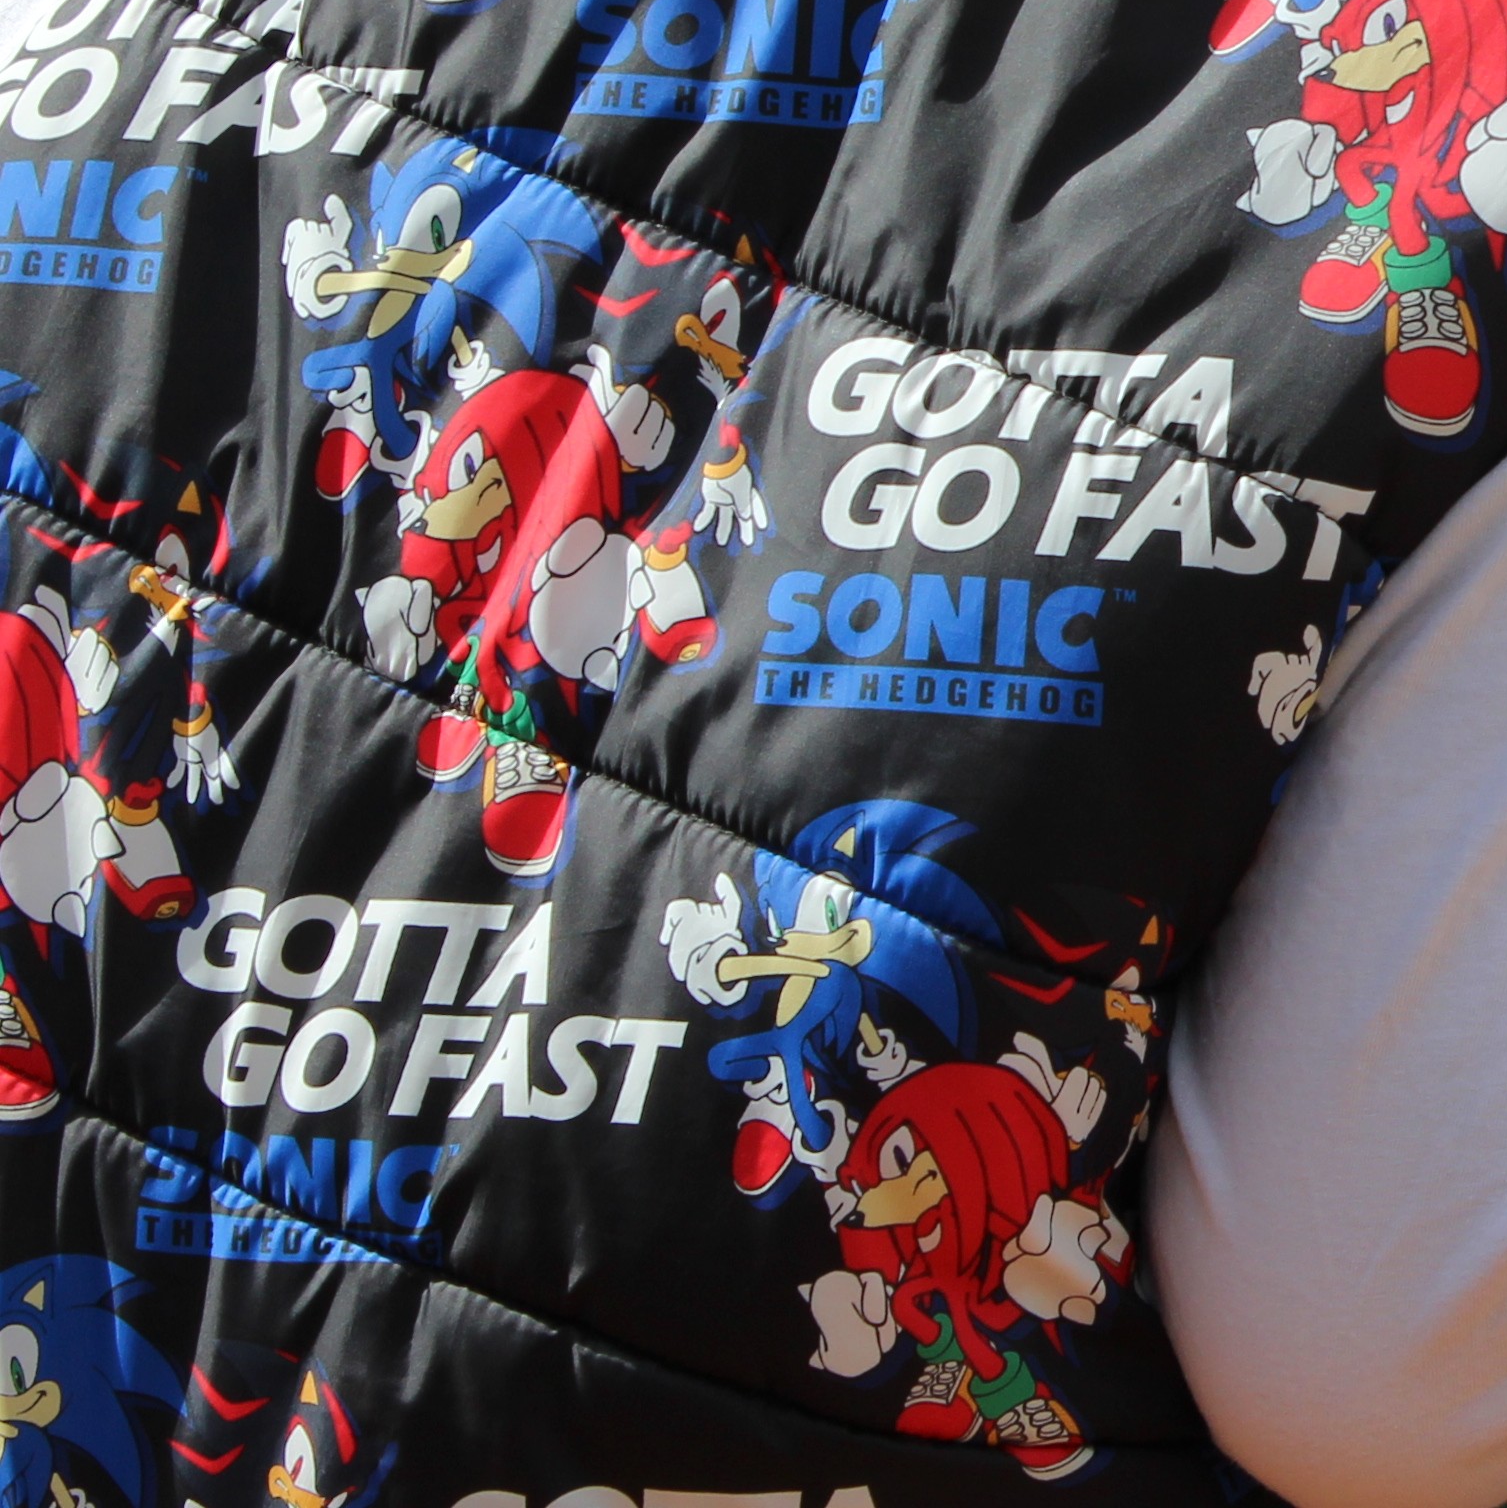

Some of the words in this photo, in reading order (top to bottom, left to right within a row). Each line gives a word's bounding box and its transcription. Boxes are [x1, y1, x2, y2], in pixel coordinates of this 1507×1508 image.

[122, 46, 425, 157] FAST
[581, 80, 648, 109] THE
[0, 159, 179, 246] NIC
[0, 249, 156, 286] GEHOG
[808, 337, 1235, 458] GOTTA
[821, 441, 1021, 552] GO
[1034, 452, 1377, 582] FAST
[761, 571, 1106, 673] SONIC
[763, 670, 835, 704] THE
[860, 676, 1099, 720] HEDGEHOG
[177, 886, 552, 1007] GOTTA
[203, 1001, 377, 1114] GO
[387, 1013, 689, 1125] FAST
[140, 1125, 443, 1229] SONIC
